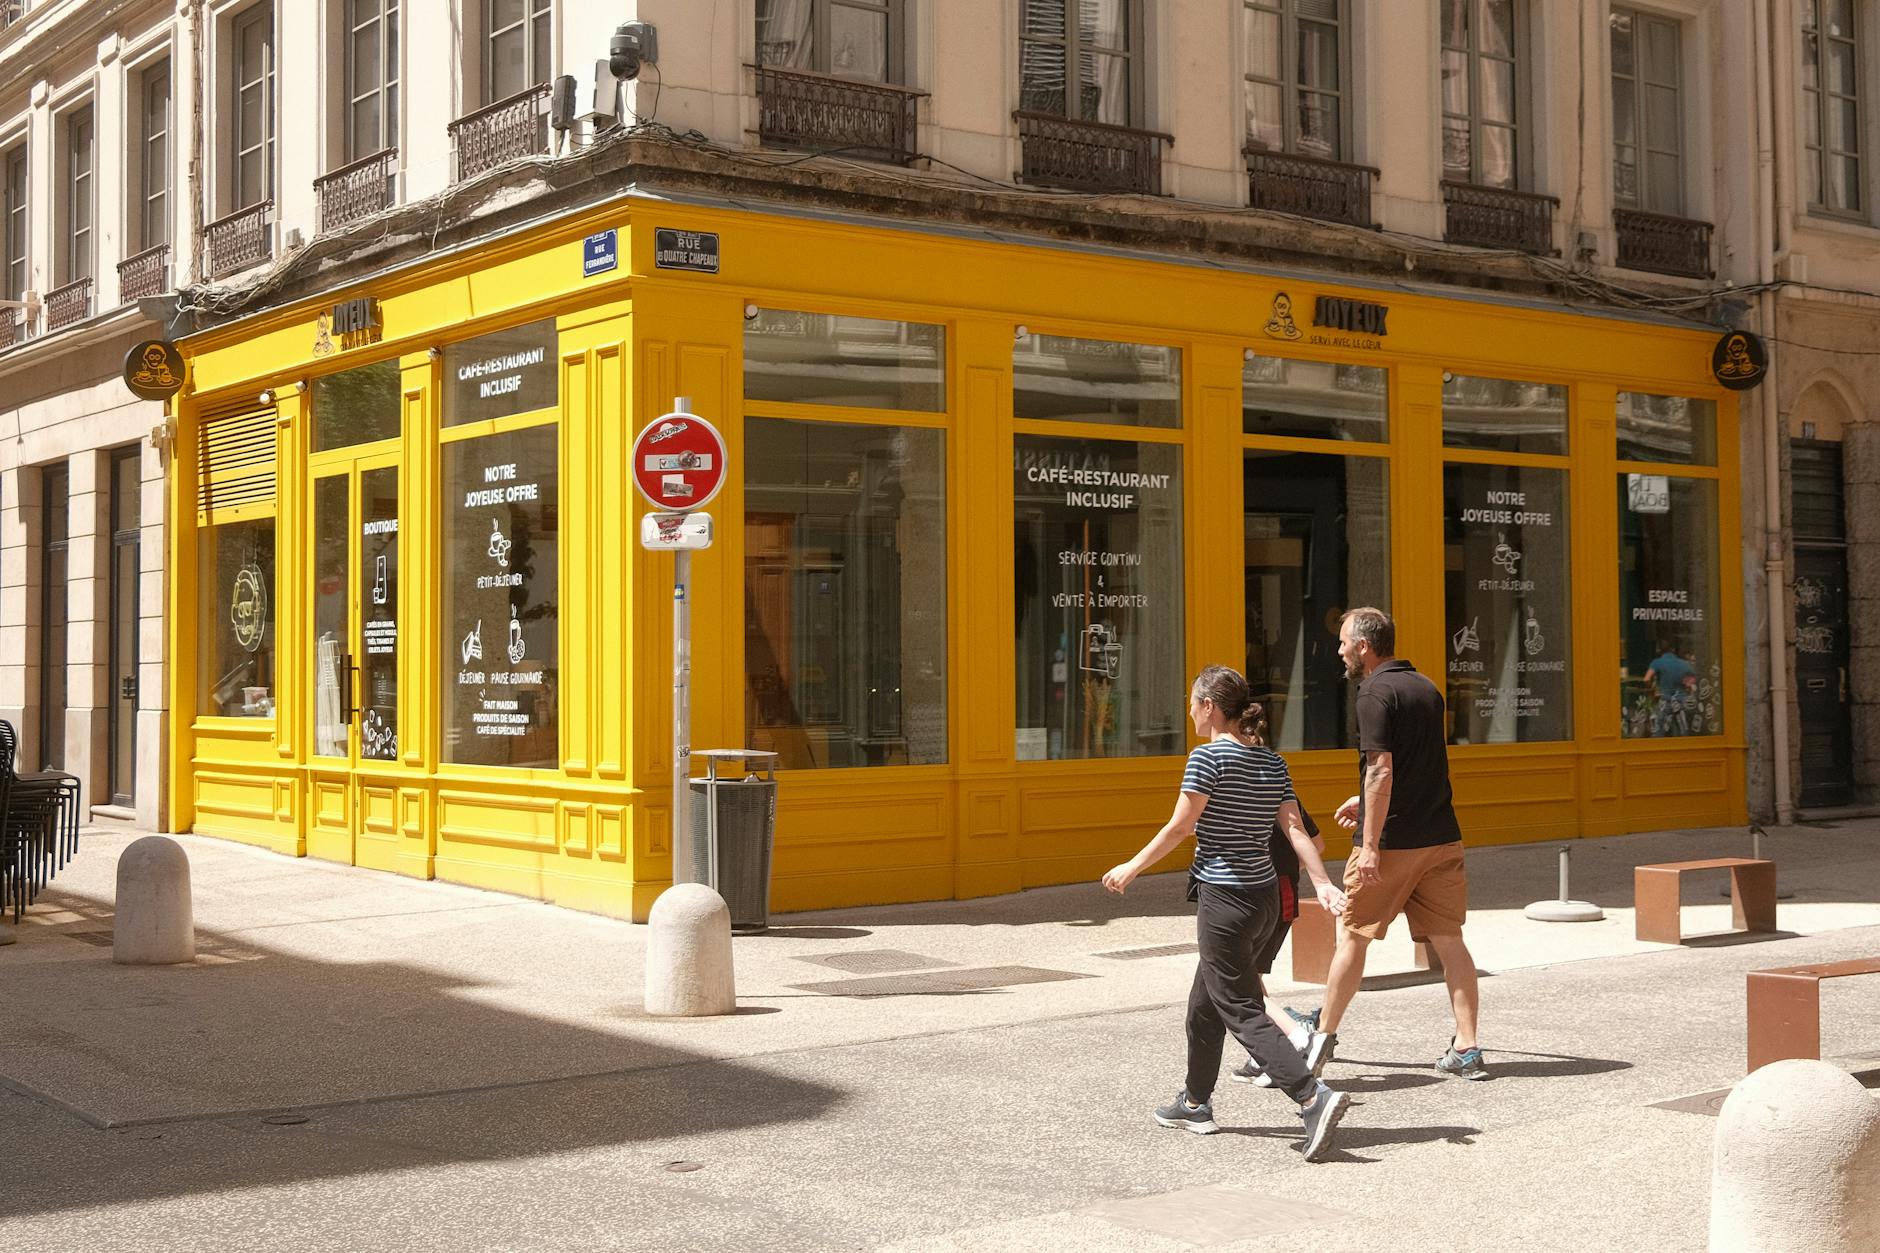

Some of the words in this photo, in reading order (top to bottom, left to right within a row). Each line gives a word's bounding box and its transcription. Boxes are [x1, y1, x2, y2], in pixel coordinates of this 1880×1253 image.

[594, 244, 605, 255] RUE
[678, 238, 701, 250] RUE
[663, 250, 688, 263] QUATRE
[688, 252, 718, 266] CHAPEAUX
[1312, 296, 1389, 336] JOYEUX
[458, 347, 545, 381] CAFÉ-RESTAURANT
[480, 375, 522, 398] INCLUSIF
[485, 463, 517, 482] NOTRE
[1027, 465, 1170, 489] CAFÉ-RESTAURANT
[464, 488, 505, 508] JOYEUSE
[506, 483, 538, 503] OFFRE
[1066, 491, 1134, 509] INCLUSIF
[1487, 490, 1526, 506] NOTRE
[1460, 508, 1513, 524] JOYEUSE
[1514, 511, 1551, 526] OFFRE
[364, 519, 398, 536] BOUTIQUE
[1097, 575, 1104, 588] &
[1052, 592, 1085, 608] VENTE
[1088, 591, 1096, 607] À
[1098, 593, 1149, 608] EMPORTER
[1648, 590, 1688, 603] ESPACE
[1632, 607, 1703, 621] PRIVATISABLE
[1449, 658, 1484, 672] DÉJEUNER
[459, 668, 486, 684] DÉJEUNER
[491, 672, 510, 685] PAUSE
[510, 670, 543, 685] GOURMANDE
[483, 700, 496, 710] FAIT
[497, 700, 519, 710] MAISON
[1520, 698, 1544, 706] SAISON
[473, 713, 500, 723] PRODUITS
[500, 714, 508, 723] DE
[508, 714, 530, 724] SAISON
[476, 724, 490, 735] CAFÉ
